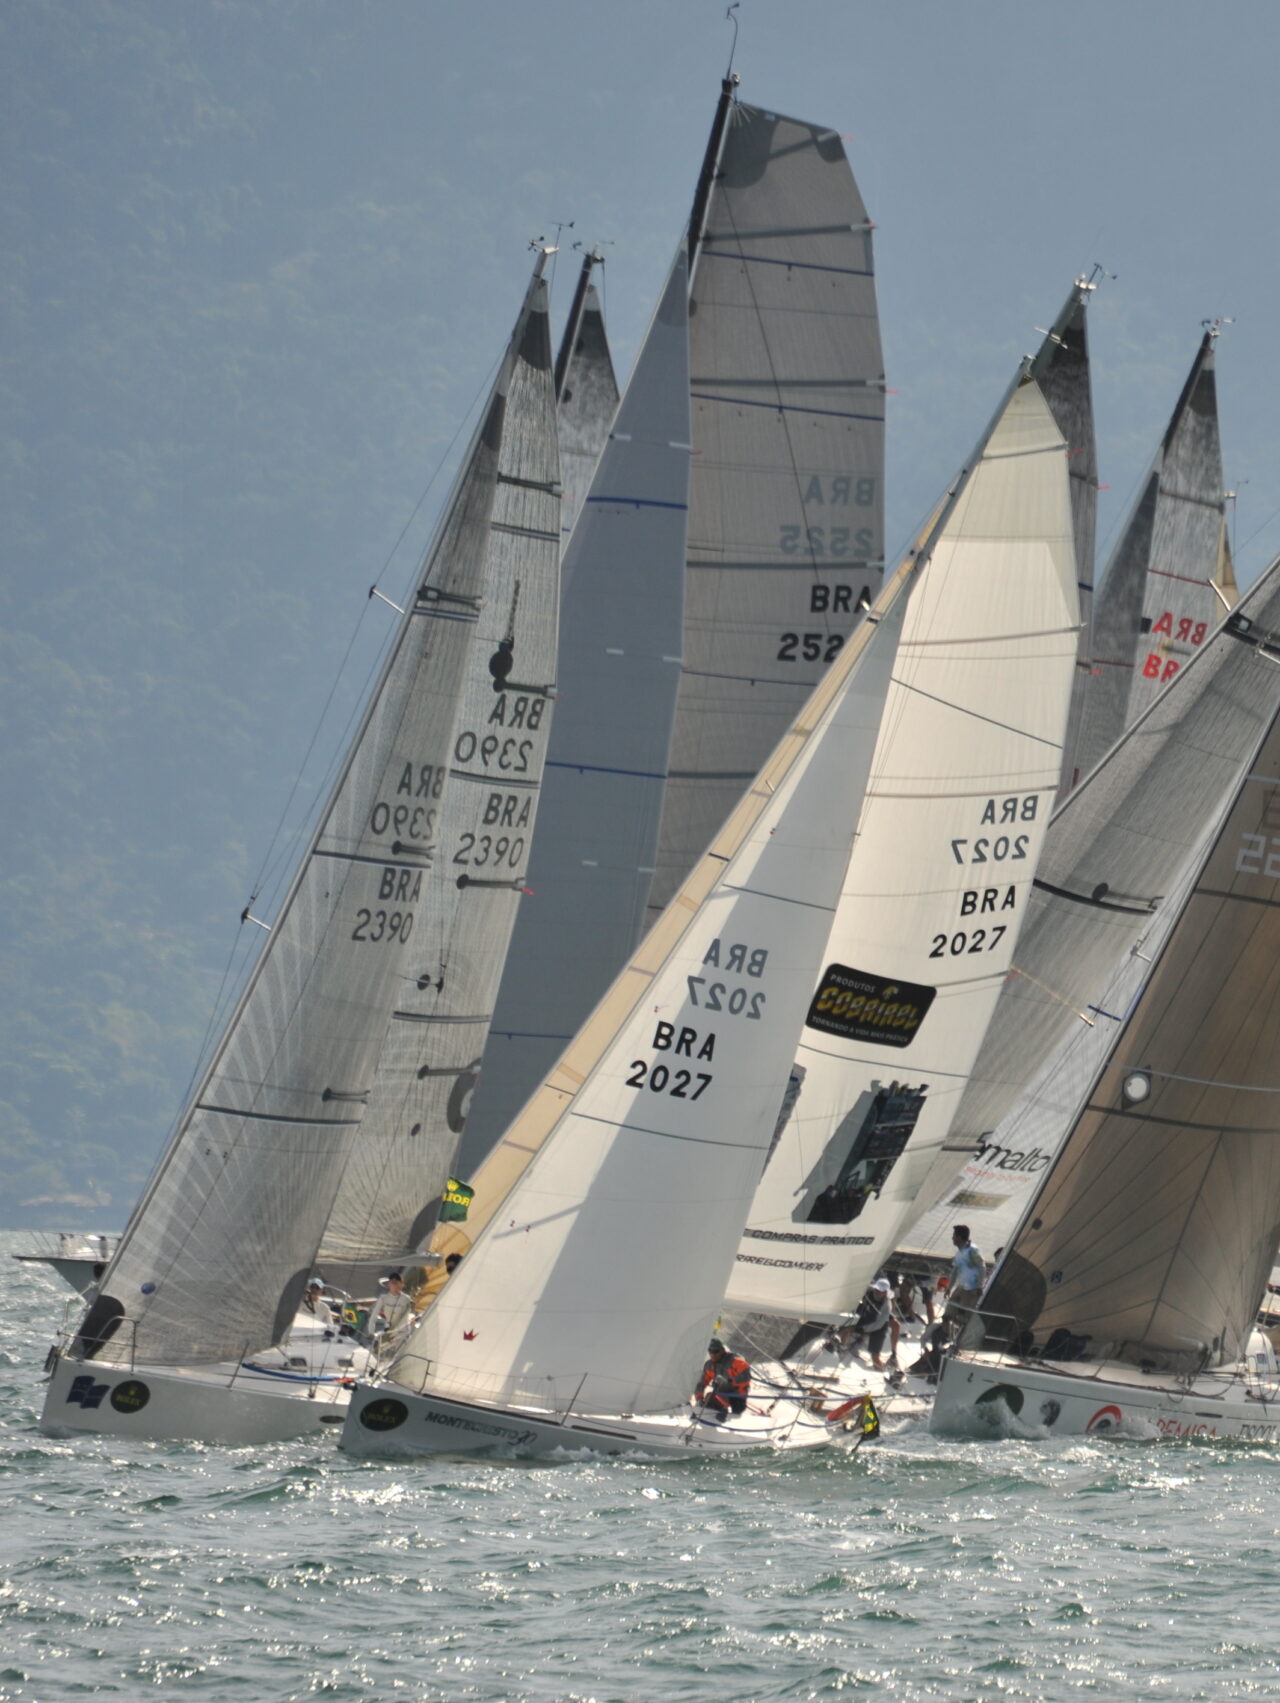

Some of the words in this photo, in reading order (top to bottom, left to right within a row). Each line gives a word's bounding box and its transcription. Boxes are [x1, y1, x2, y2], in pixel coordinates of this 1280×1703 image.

[810, 584, 872, 614] BRA
[777, 632, 845, 664] 252
[1142, 653, 1180, 683] BR
[482, 793, 532, 828] BRA
[453, 832, 524, 868] 2390
[379, 867, 423, 902] BRA
[960, 885, 1016, 917] BRA
[352, 909, 414, 944] 2390
[929, 925, 1007, 959] 2027
[830, 974, 877, 993] PRODUTOS
[652, 1021, 716, 1062] BRA
[625, 1060, 713, 1101] 2027
[751, 1229, 818, 1244] COMPRAS
